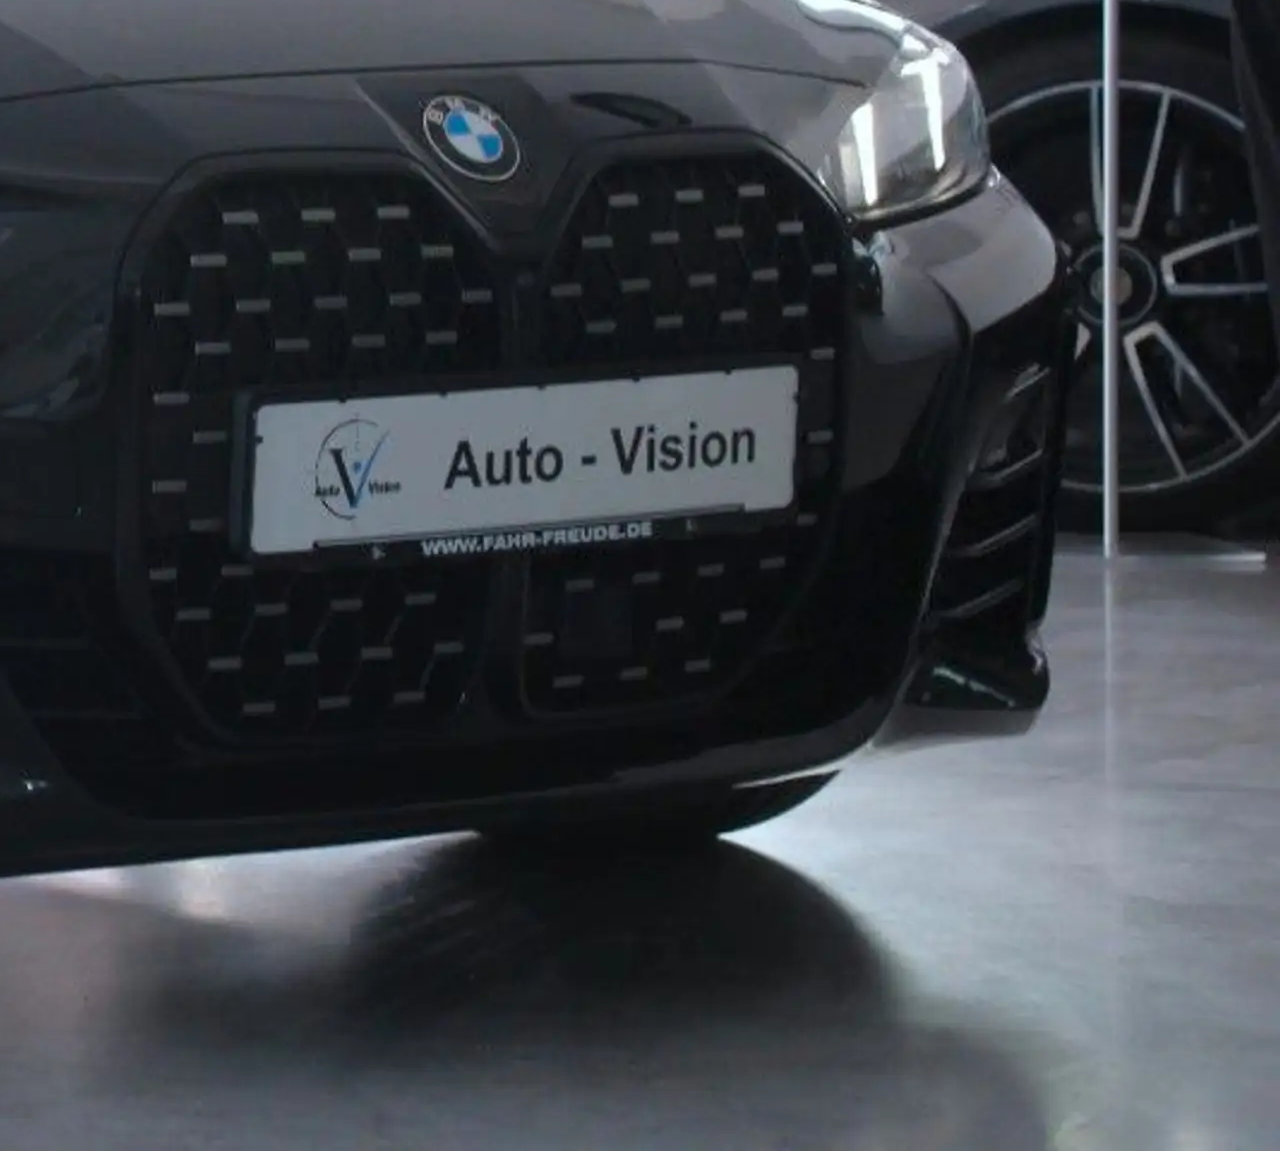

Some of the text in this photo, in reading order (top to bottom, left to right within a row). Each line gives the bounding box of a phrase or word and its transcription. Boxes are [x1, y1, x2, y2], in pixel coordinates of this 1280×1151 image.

[443, 421, 756, 490] Auto - Vision
[420, 521, 653, 556] WWW.FAHR-FREUDE.DE
